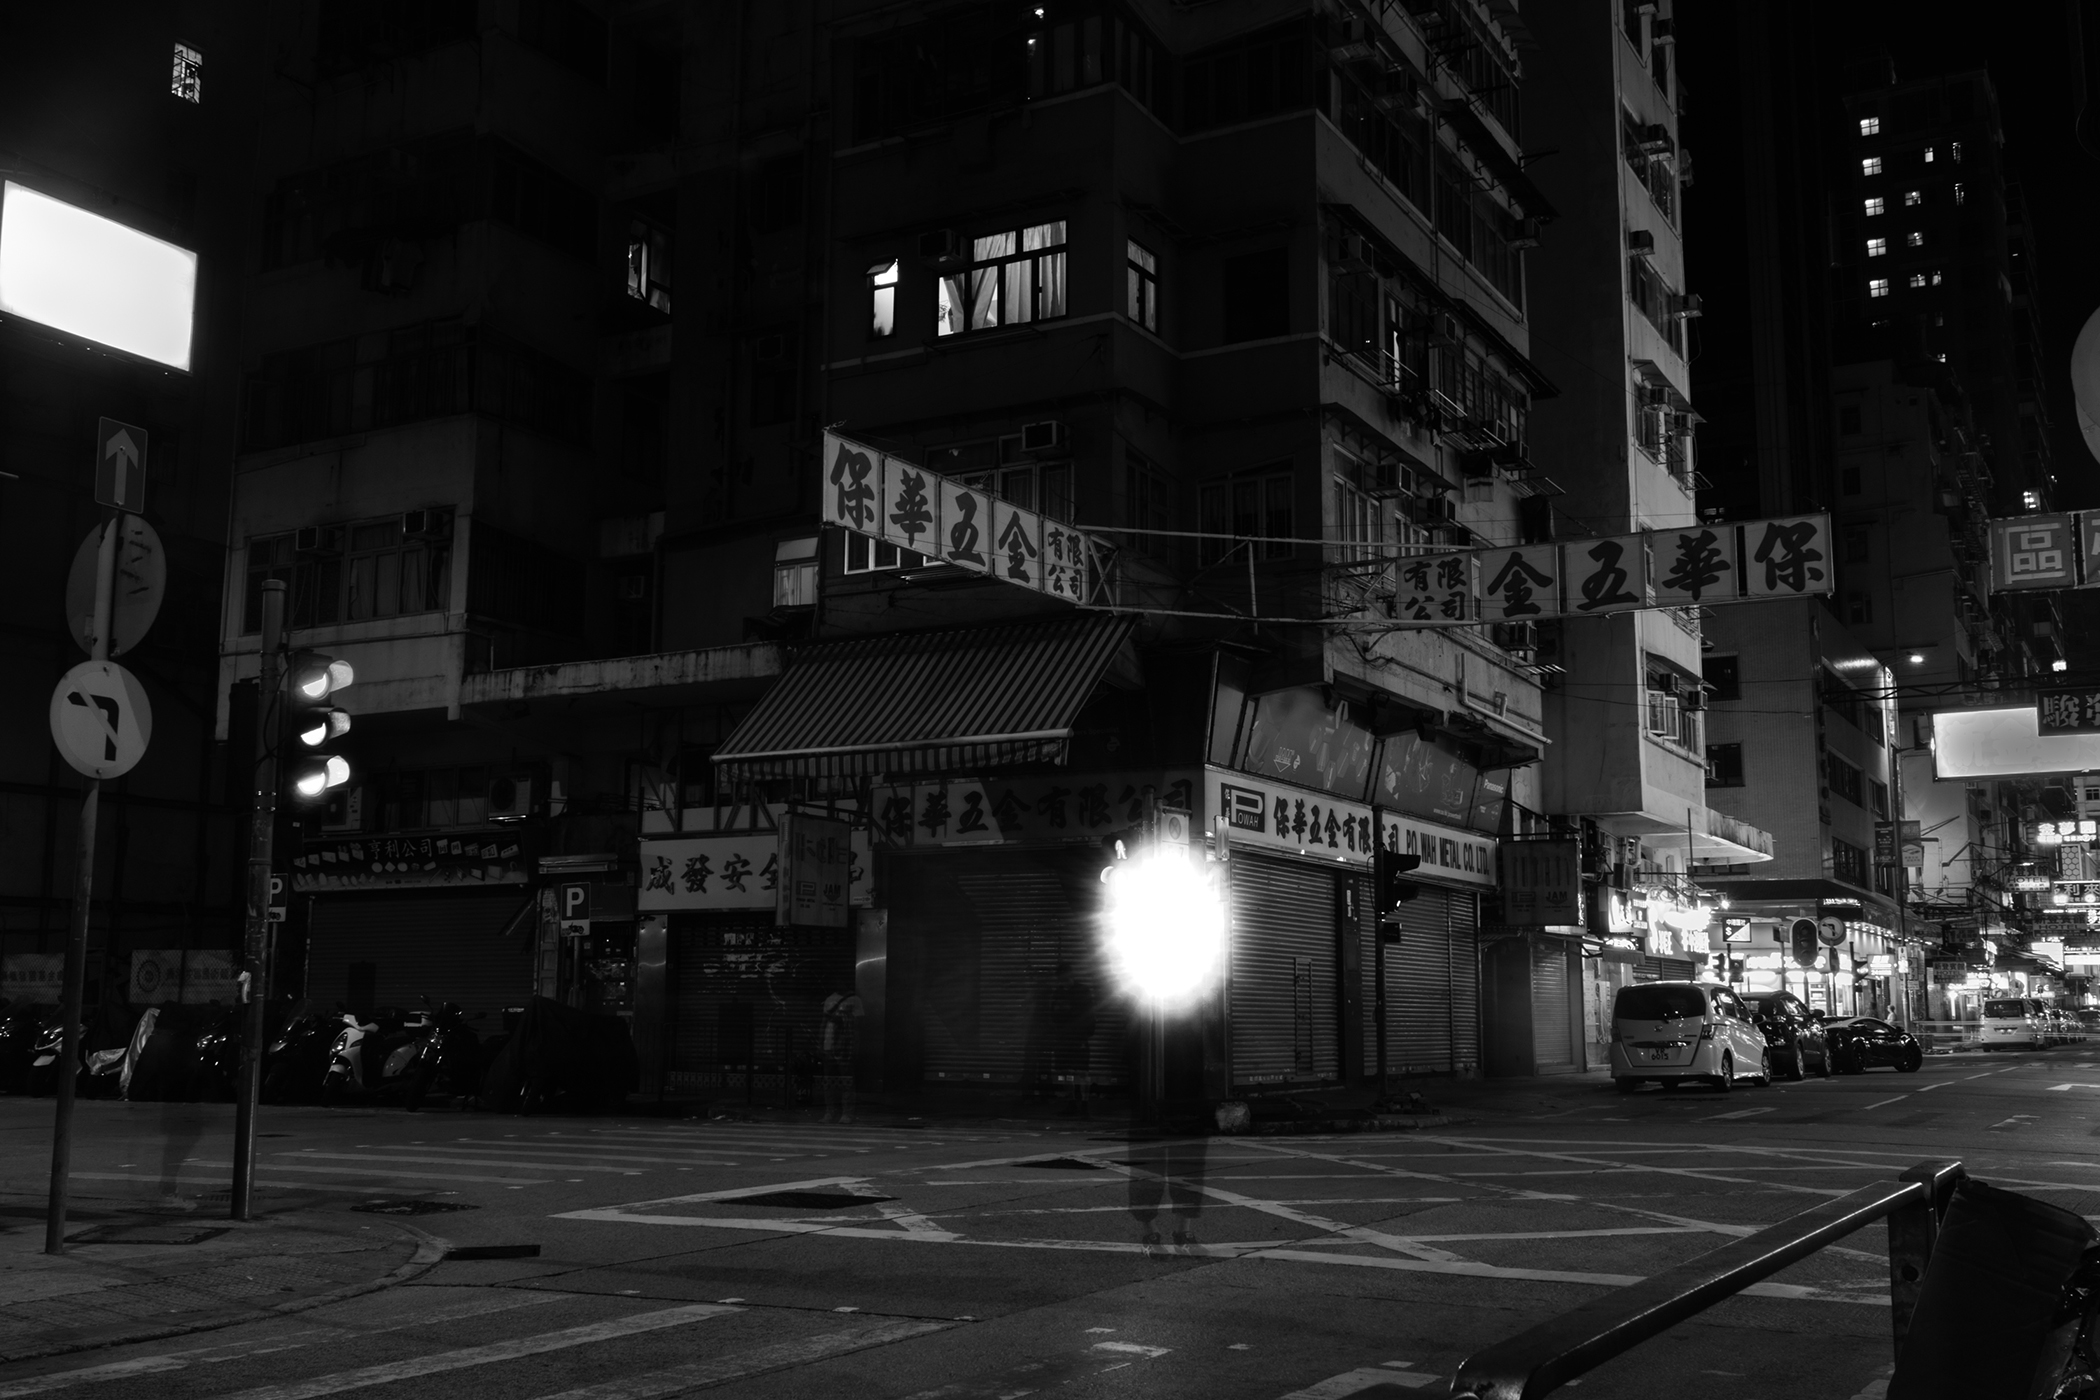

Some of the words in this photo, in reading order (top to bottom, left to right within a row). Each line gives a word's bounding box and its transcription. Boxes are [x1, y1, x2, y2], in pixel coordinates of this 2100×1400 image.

[1483, 778, 1504, 795] Panasonic
[1274, 796, 1398, 854] 保華五金有限司
[367, 838, 433, 859] 亨利公司
[1420, 832, 1437, 866] WAH
[1439, 837, 1462, 870] METAL
[1463, 843, 1475, 873] CO.
[1476, 845, 1490, 875] LTD.
[823, 884, 841, 895] JAM
[1545, 891, 1568, 901] JAM
[566, 887, 585, 917] P
